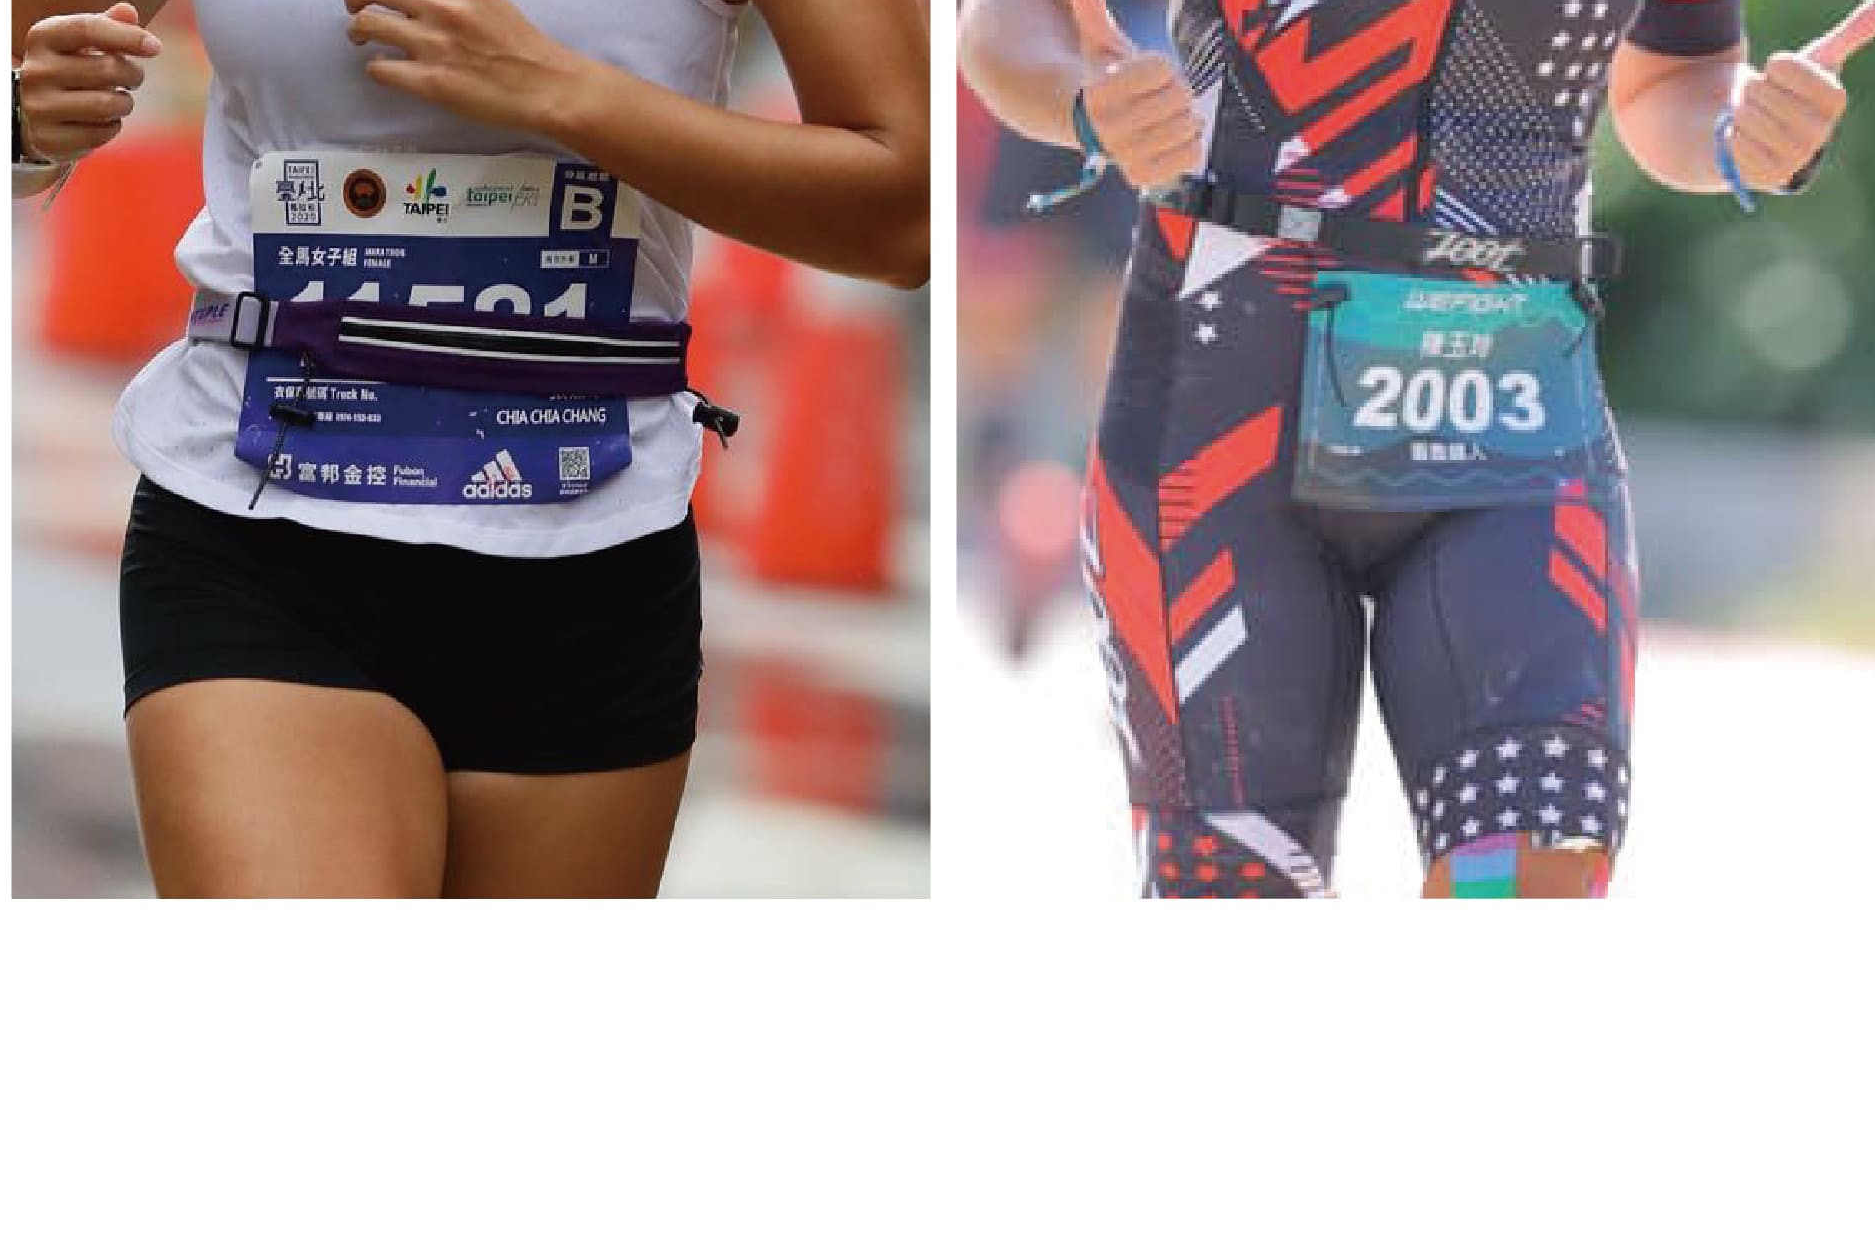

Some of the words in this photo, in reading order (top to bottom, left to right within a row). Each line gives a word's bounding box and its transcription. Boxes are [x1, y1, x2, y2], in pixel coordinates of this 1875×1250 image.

[403, 203, 449, 215] TAIPEI
[561, 185, 605, 230] B
[278, 246, 357, 267] 全馬女子組
[331, 387, 357, 400] Truck
[360, 389, 378, 401] No.
[1353, 365, 1545, 433] 2003
[496, 409, 528, 425] CHIA
[530, 408, 560, 424] CHIA
[562, 407, 606, 424] CHANG
[298, 461, 386, 486] 富邦金控
[393, 464, 424, 476] Fubon
[393, 476, 437, 488] Financial
[462, 482, 532, 499] adidas
